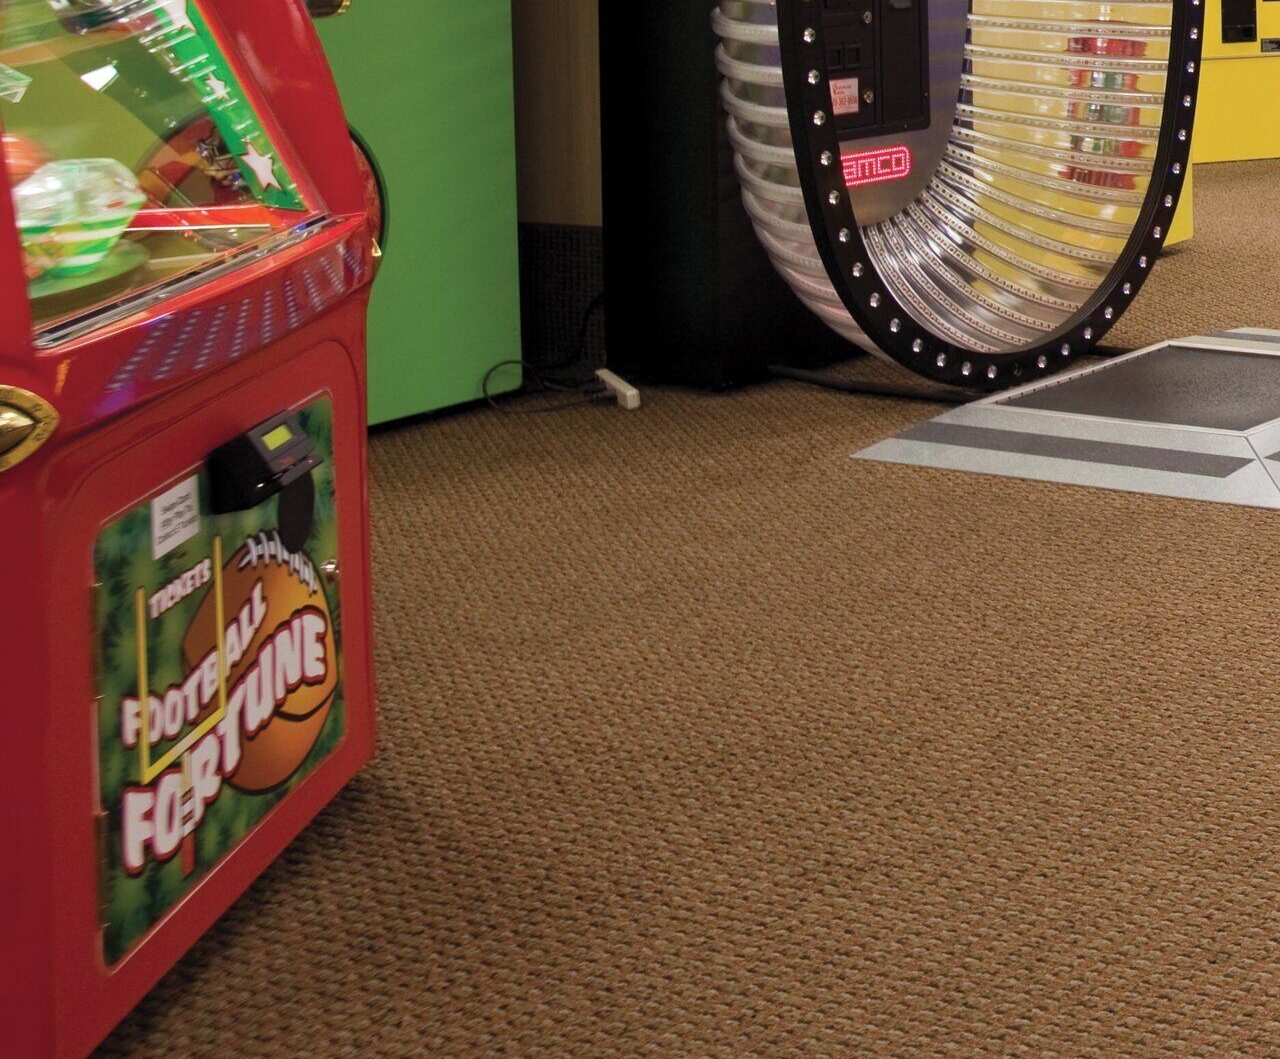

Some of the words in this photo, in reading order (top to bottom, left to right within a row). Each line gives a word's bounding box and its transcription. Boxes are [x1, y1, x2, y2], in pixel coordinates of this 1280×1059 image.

[121, 576, 267, 750] FOOTBALL
[148, 557, 213, 620] TICKETS
[121, 604, 328, 877] FORTUNE
